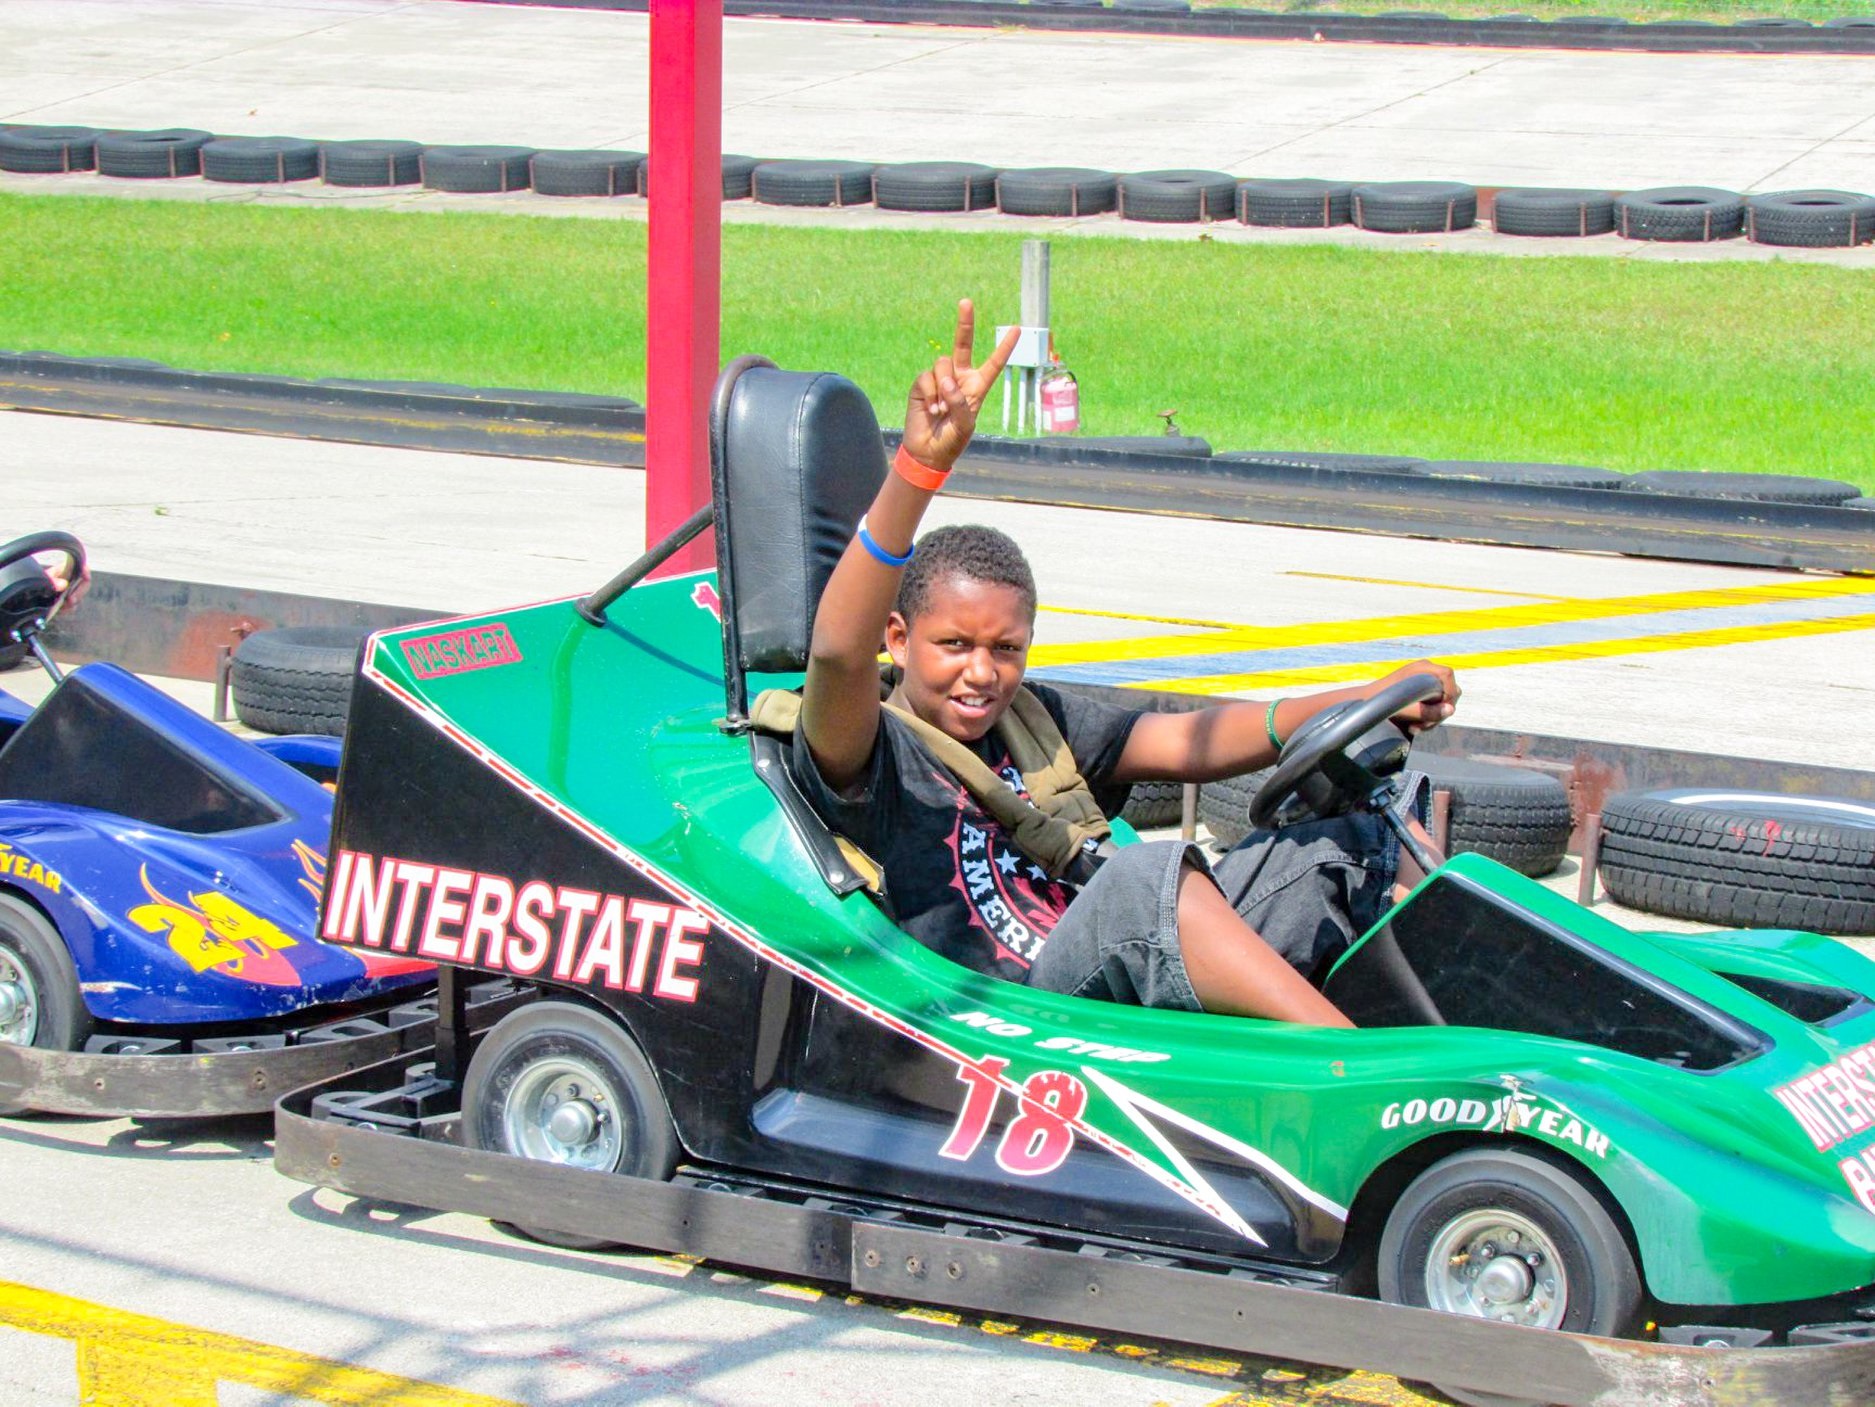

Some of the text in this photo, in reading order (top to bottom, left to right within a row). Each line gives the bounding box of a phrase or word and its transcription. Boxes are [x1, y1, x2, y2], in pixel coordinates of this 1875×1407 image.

[406, 628, 514, 675] NASKART
[126, 890, 299, 973] 24
[321, 849, 711, 1003] INTERSTATE
[949, 1011, 1172, 1063] NO STEP
[937, 1053, 1088, 1176] 18
